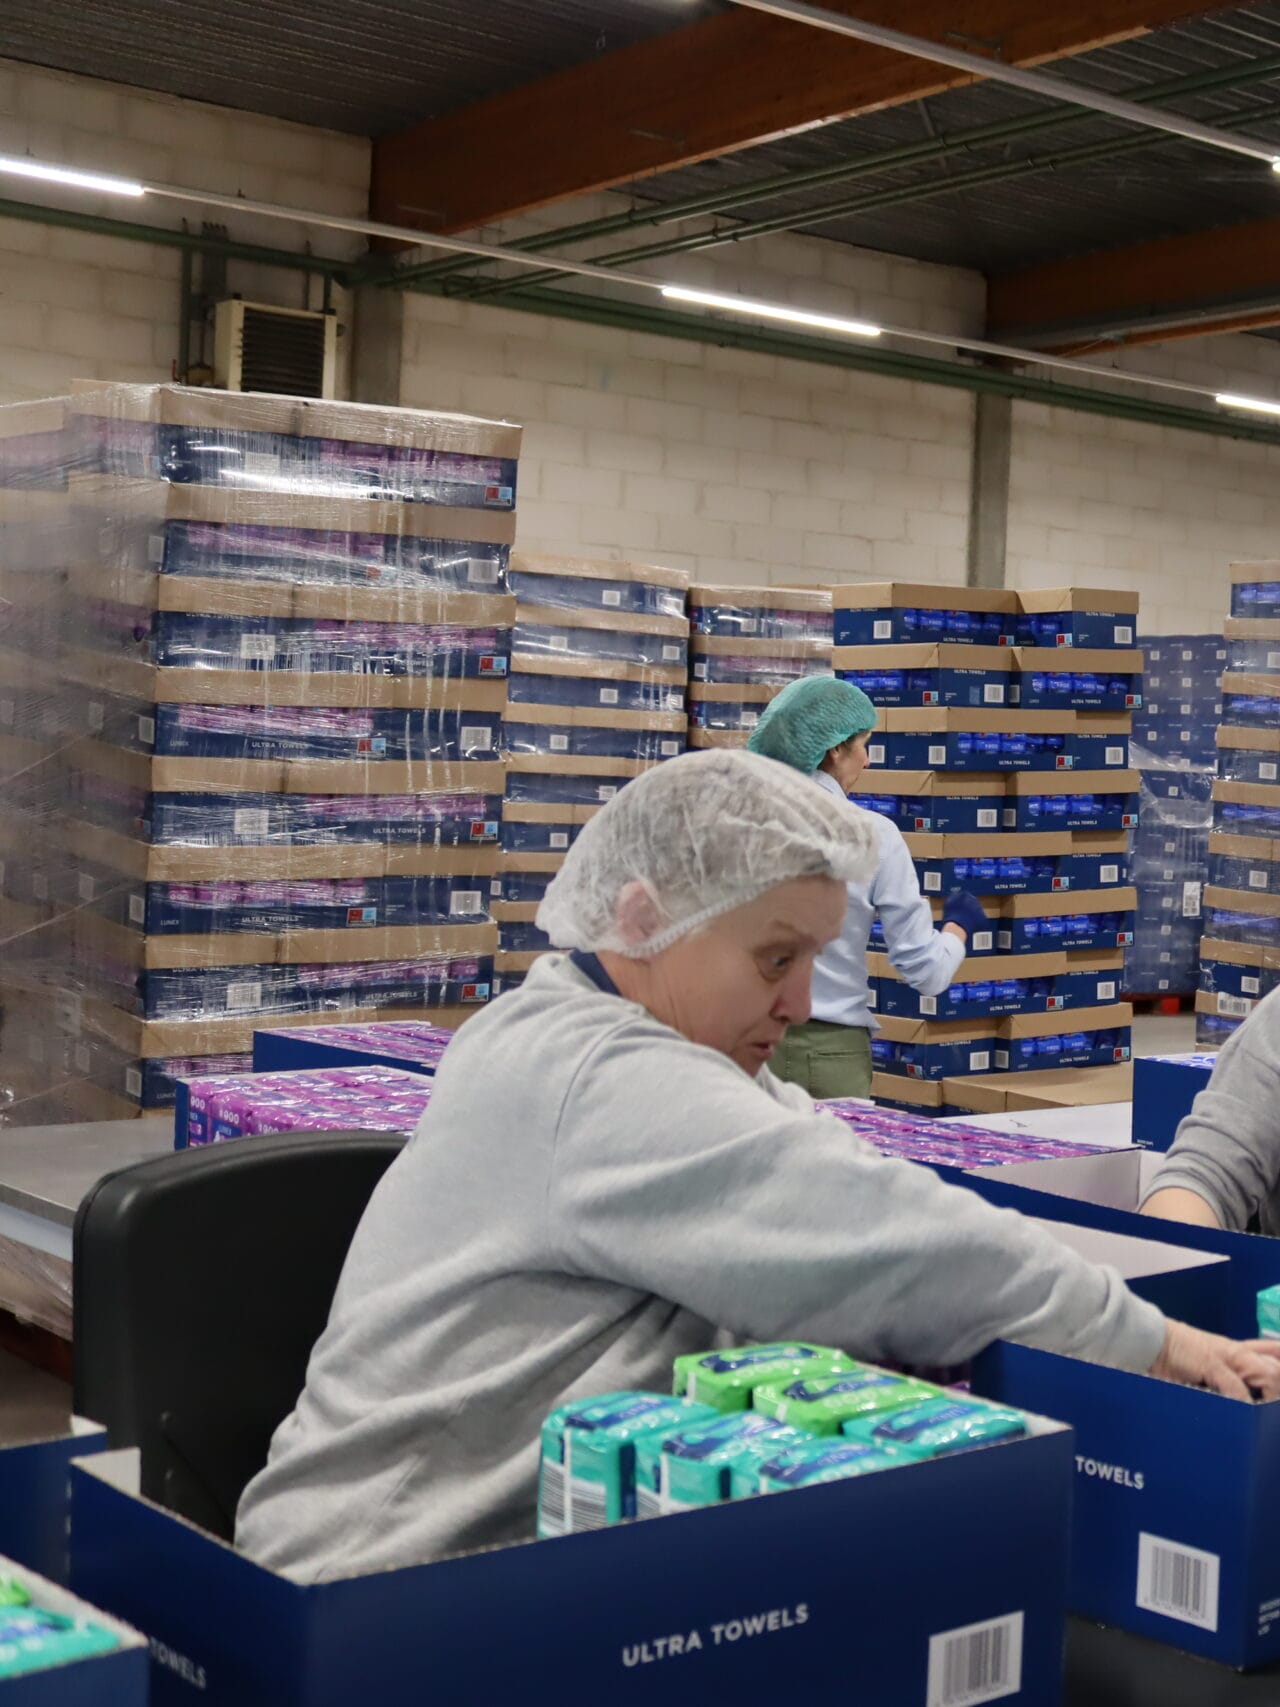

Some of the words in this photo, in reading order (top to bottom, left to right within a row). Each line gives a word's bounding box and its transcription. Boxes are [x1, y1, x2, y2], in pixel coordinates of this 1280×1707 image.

[1074, 1455, 1145, 1490] TOWELS
[622, 1630, 703, 1667] ULTRA
[711, 1604, 810, 1646] TOWELS
